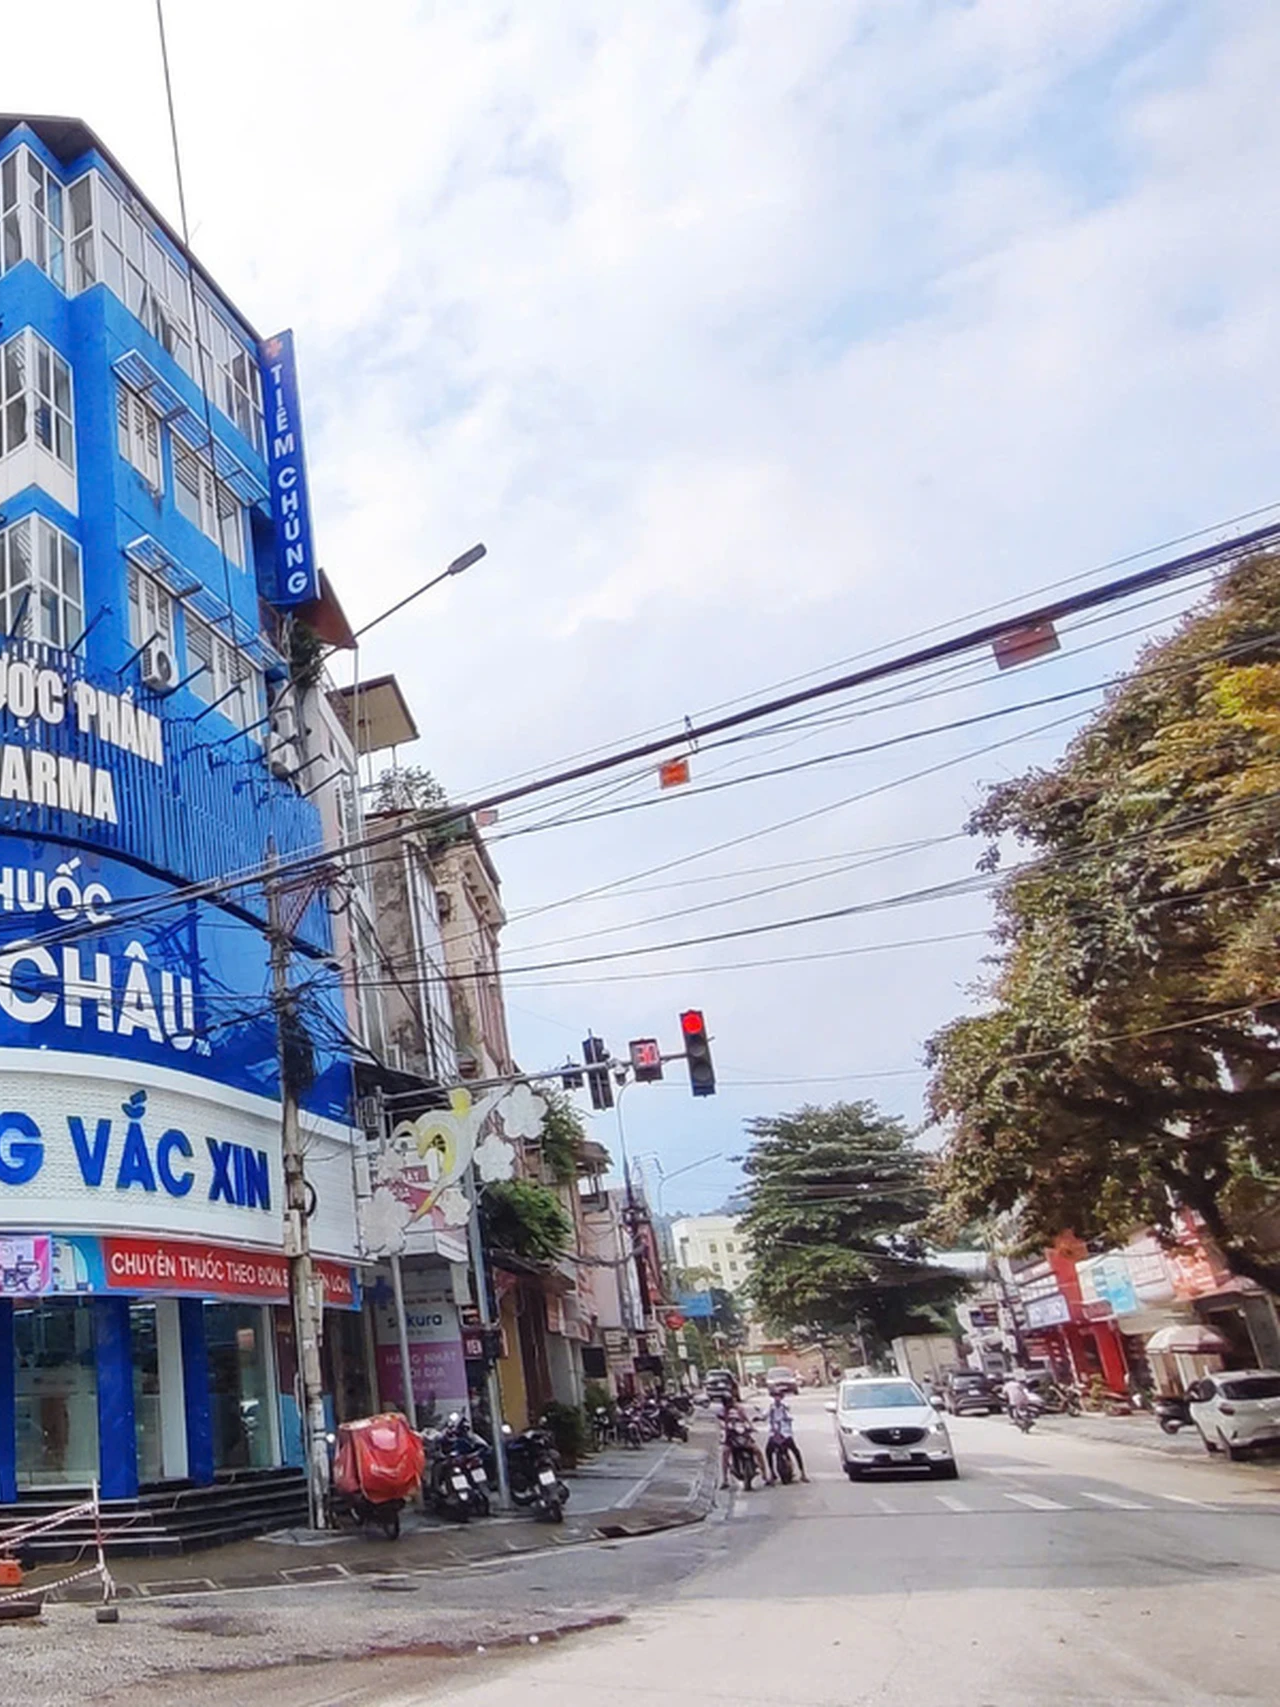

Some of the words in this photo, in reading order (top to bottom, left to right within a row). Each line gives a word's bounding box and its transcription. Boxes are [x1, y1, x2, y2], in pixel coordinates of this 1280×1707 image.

[270, 363, 295, 459] TIÊM
[67, 1089, 195, 1198] VẮC
[205, 1137, 271, 1211] XIN
[111, 1249, 176, 1277] CHUYÊN
[226, 1261, 254, 1283] THEO
[387, 1312, 442, 1329] skura
